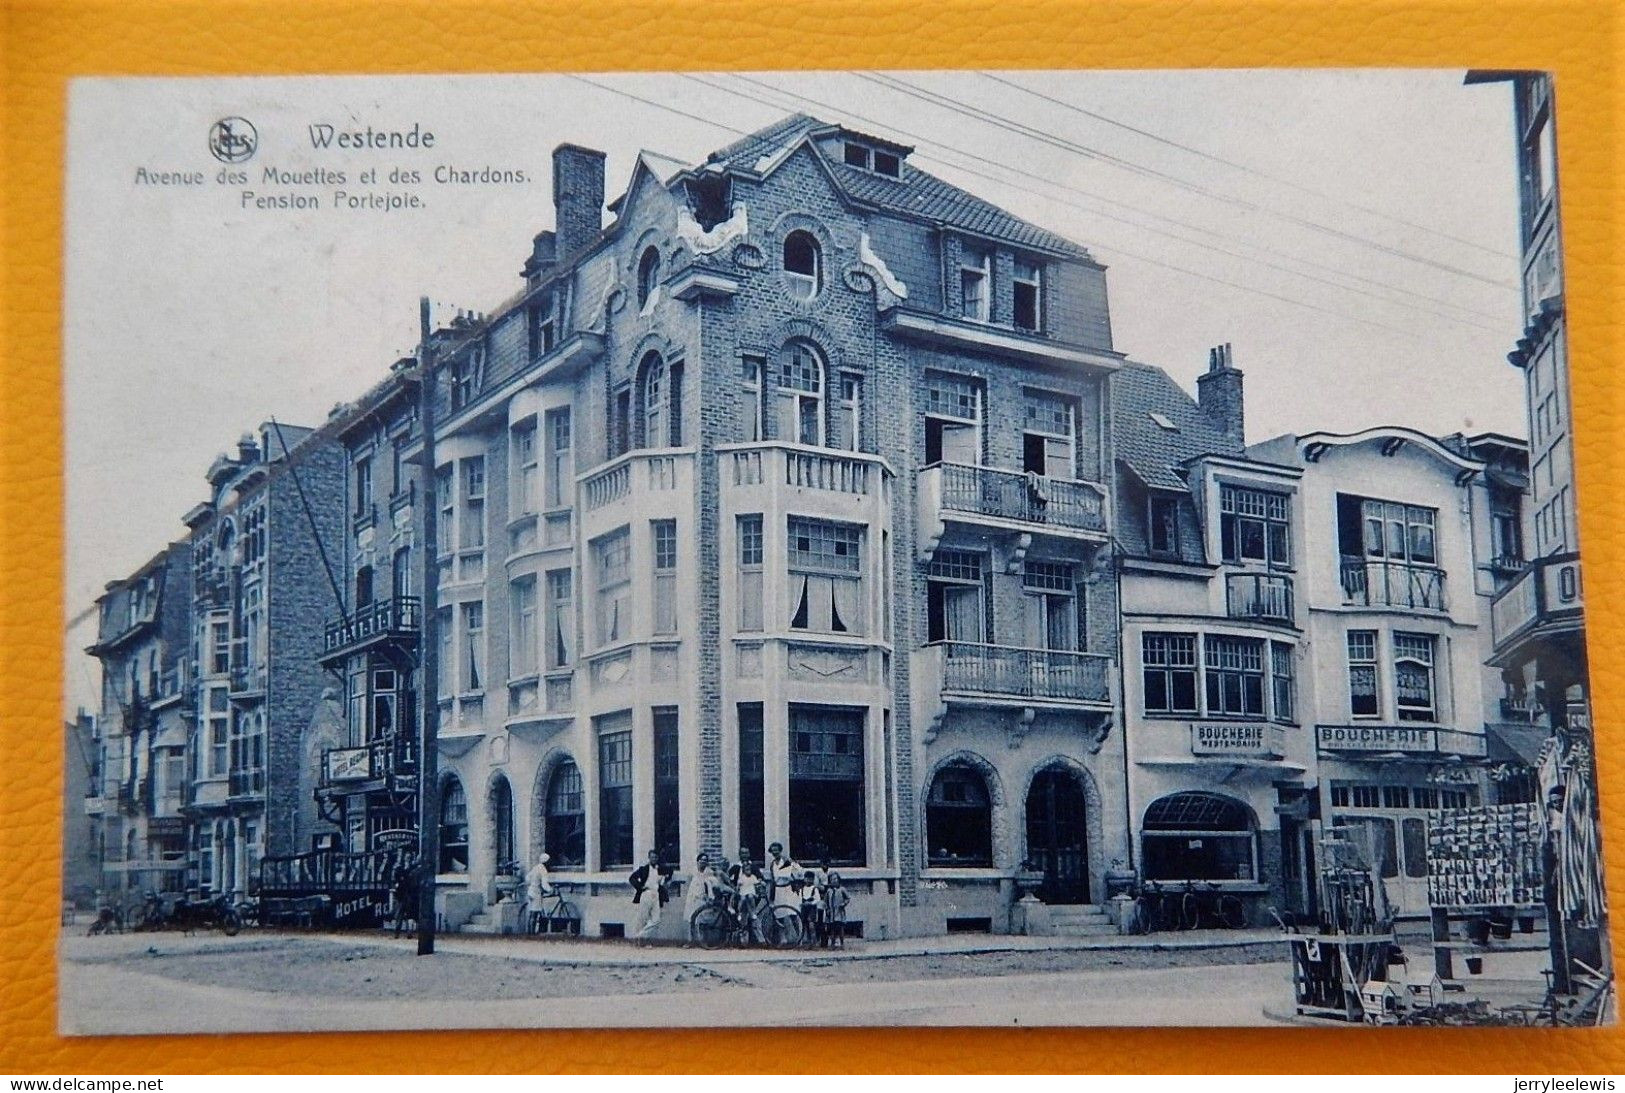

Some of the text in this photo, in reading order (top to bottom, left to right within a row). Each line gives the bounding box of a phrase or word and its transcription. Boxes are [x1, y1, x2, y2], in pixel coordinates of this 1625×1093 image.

[308, 122, 435, 149] Westende
[134, 165, 532, 185] Avenue des Mouettes et des Chardons.
[241, 190, 319, 210] Pension
[1198, 727, 1263, 740] BOUCHERIE
[1321, 728, 1430, 743] BOUCHERIE
[335, 895, 373, 919] HOTEL
